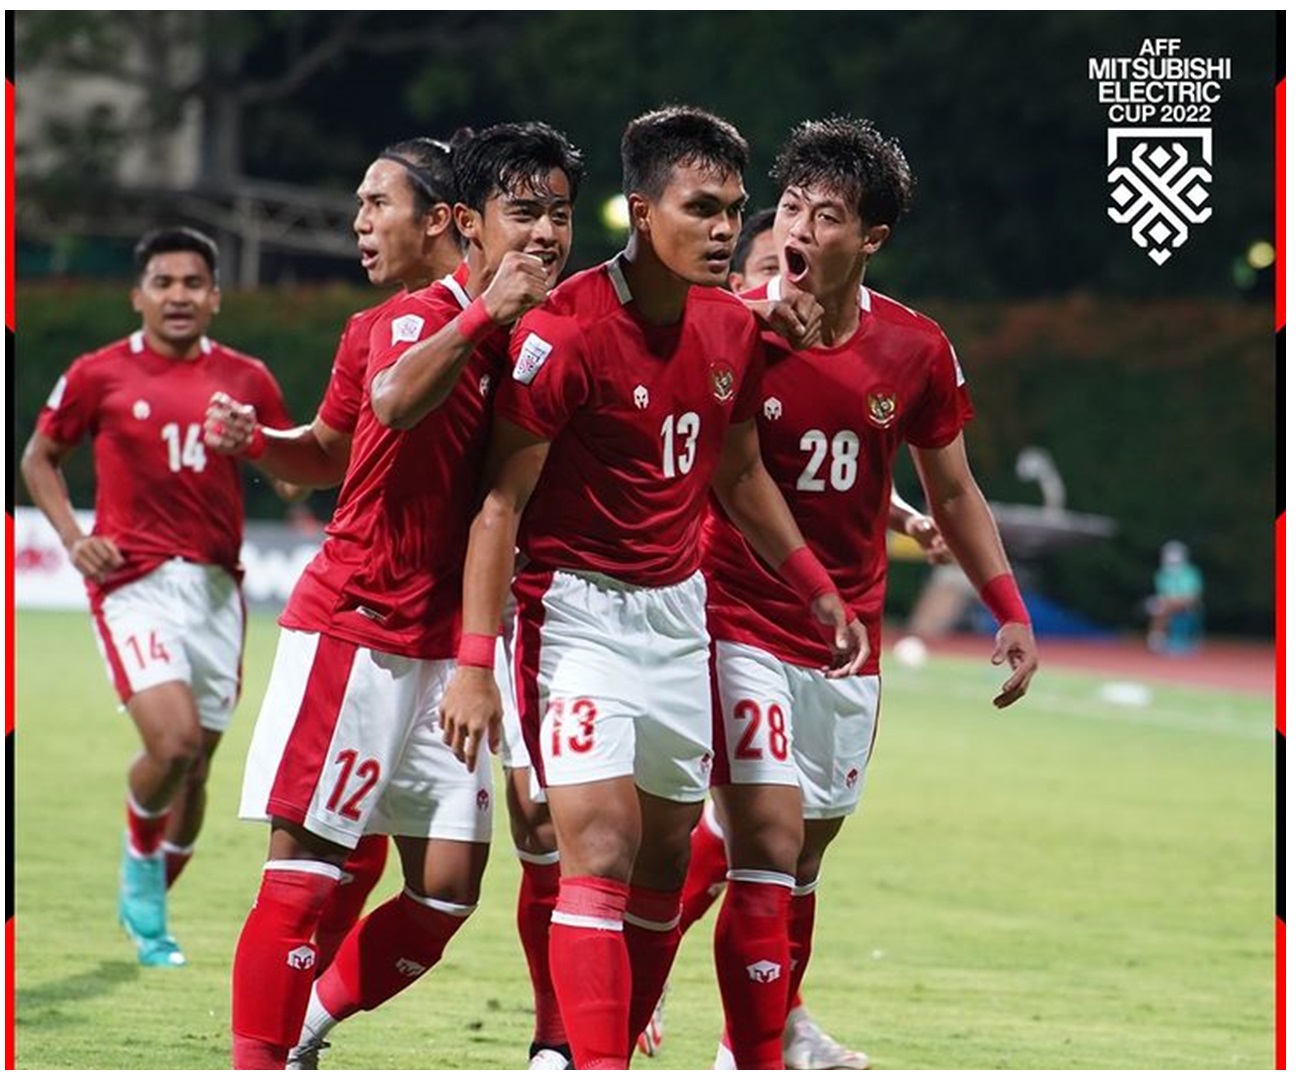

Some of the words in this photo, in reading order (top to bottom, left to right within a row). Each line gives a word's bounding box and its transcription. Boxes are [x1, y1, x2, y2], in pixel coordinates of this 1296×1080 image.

[161, 422, 207, 473] 14
[660, 411, 700, 478] 13
[796, 429, 859, 491] 28
[125, 631, 170, 670] 14
[546, 698, 597, 757] 13
[733, 698, 788, 762] 28
[324, 748, 381, 822] 12
